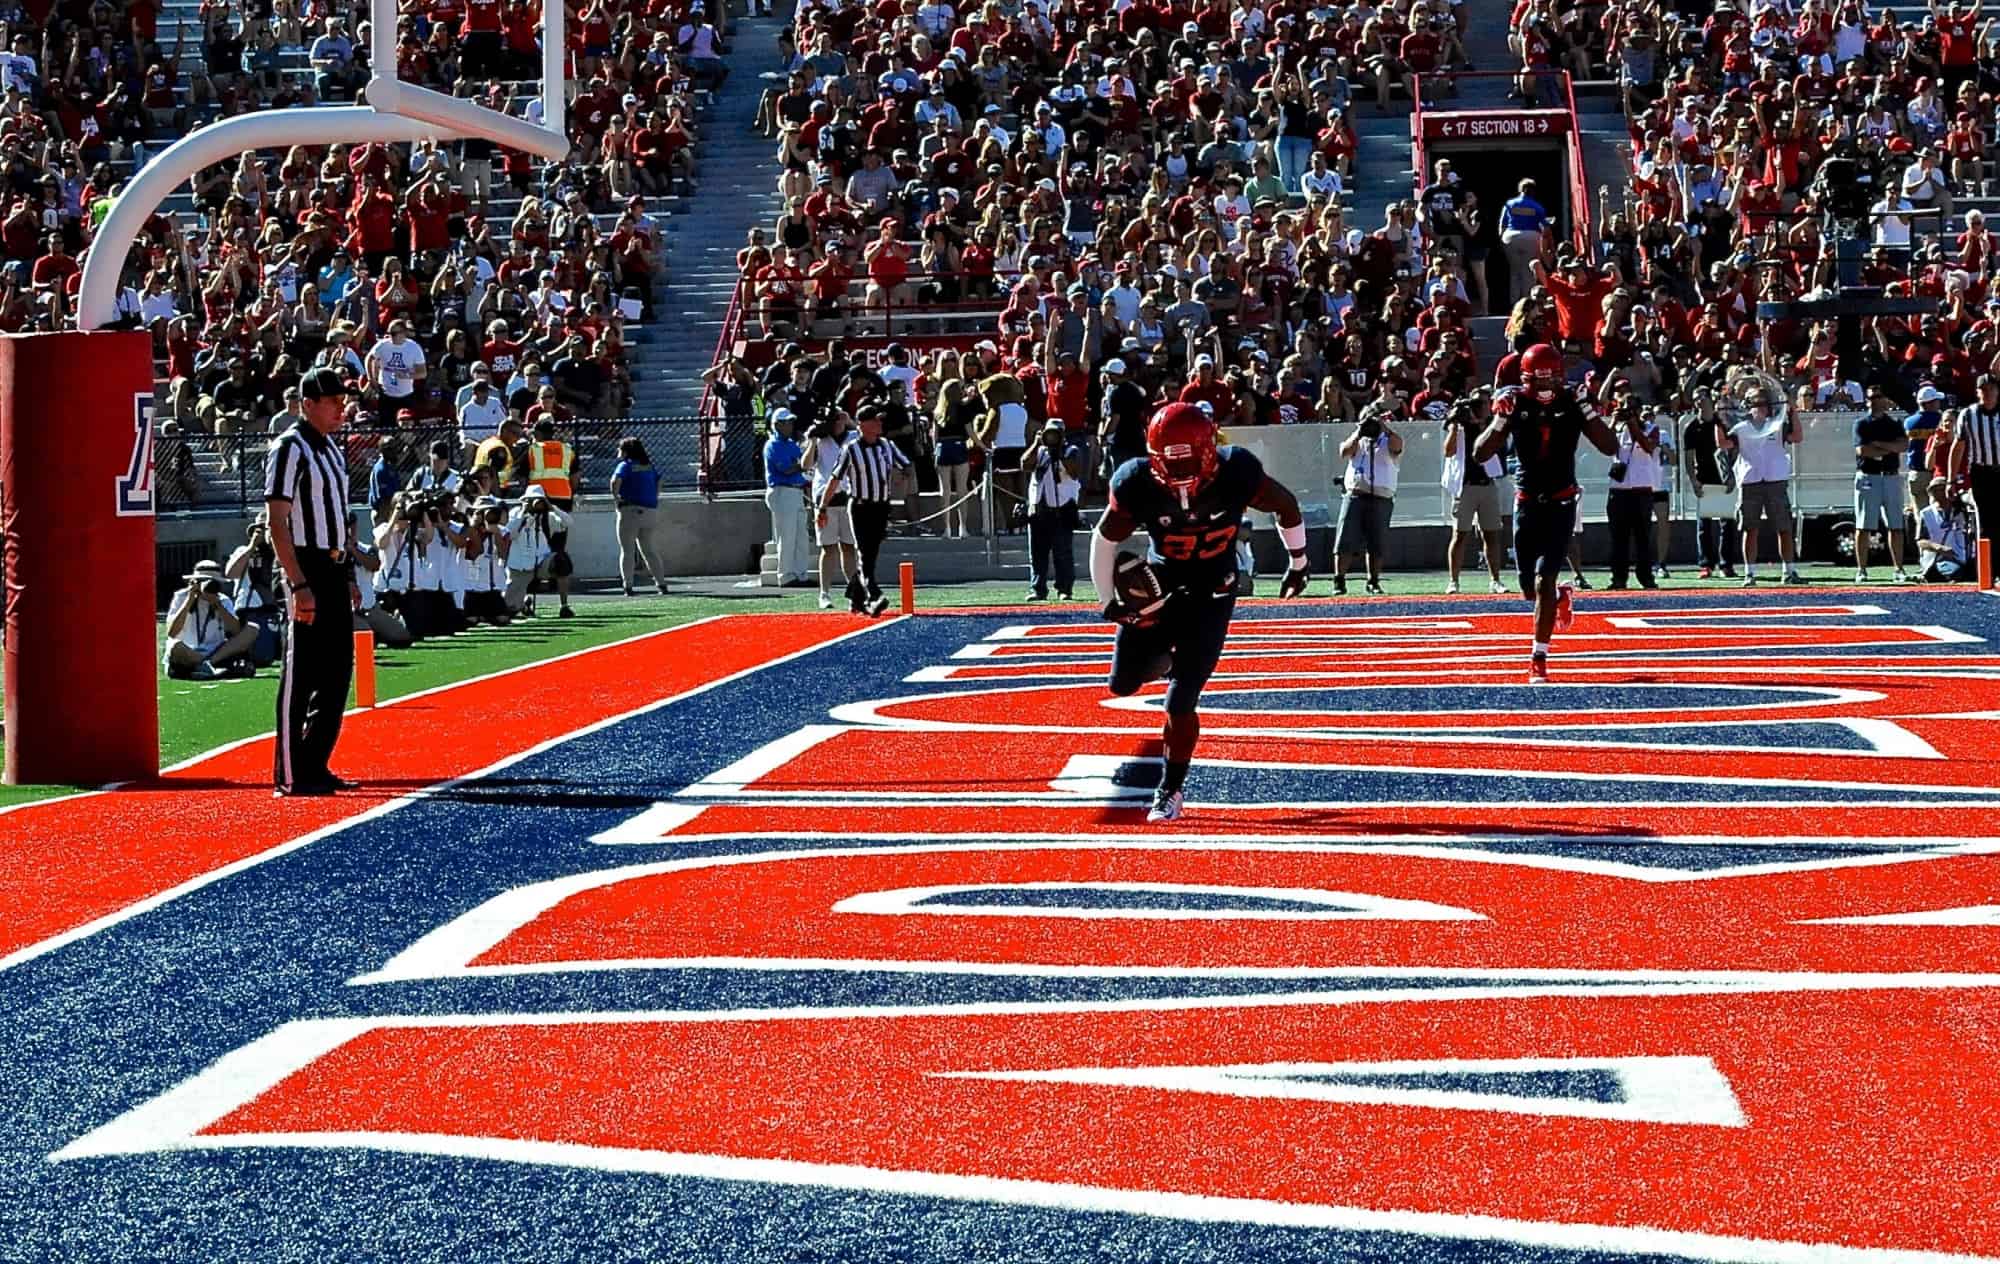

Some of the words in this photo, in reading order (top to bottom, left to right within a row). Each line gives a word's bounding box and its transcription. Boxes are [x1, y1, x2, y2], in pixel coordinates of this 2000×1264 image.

[1456, 121, 1466, 135] 17
[1471, 120, 1520, 136] SECTION
[1523, 119, 1535, 134] 18
[387, 352, 406, 369] A
[1349, 372, 1367, 387] 10
